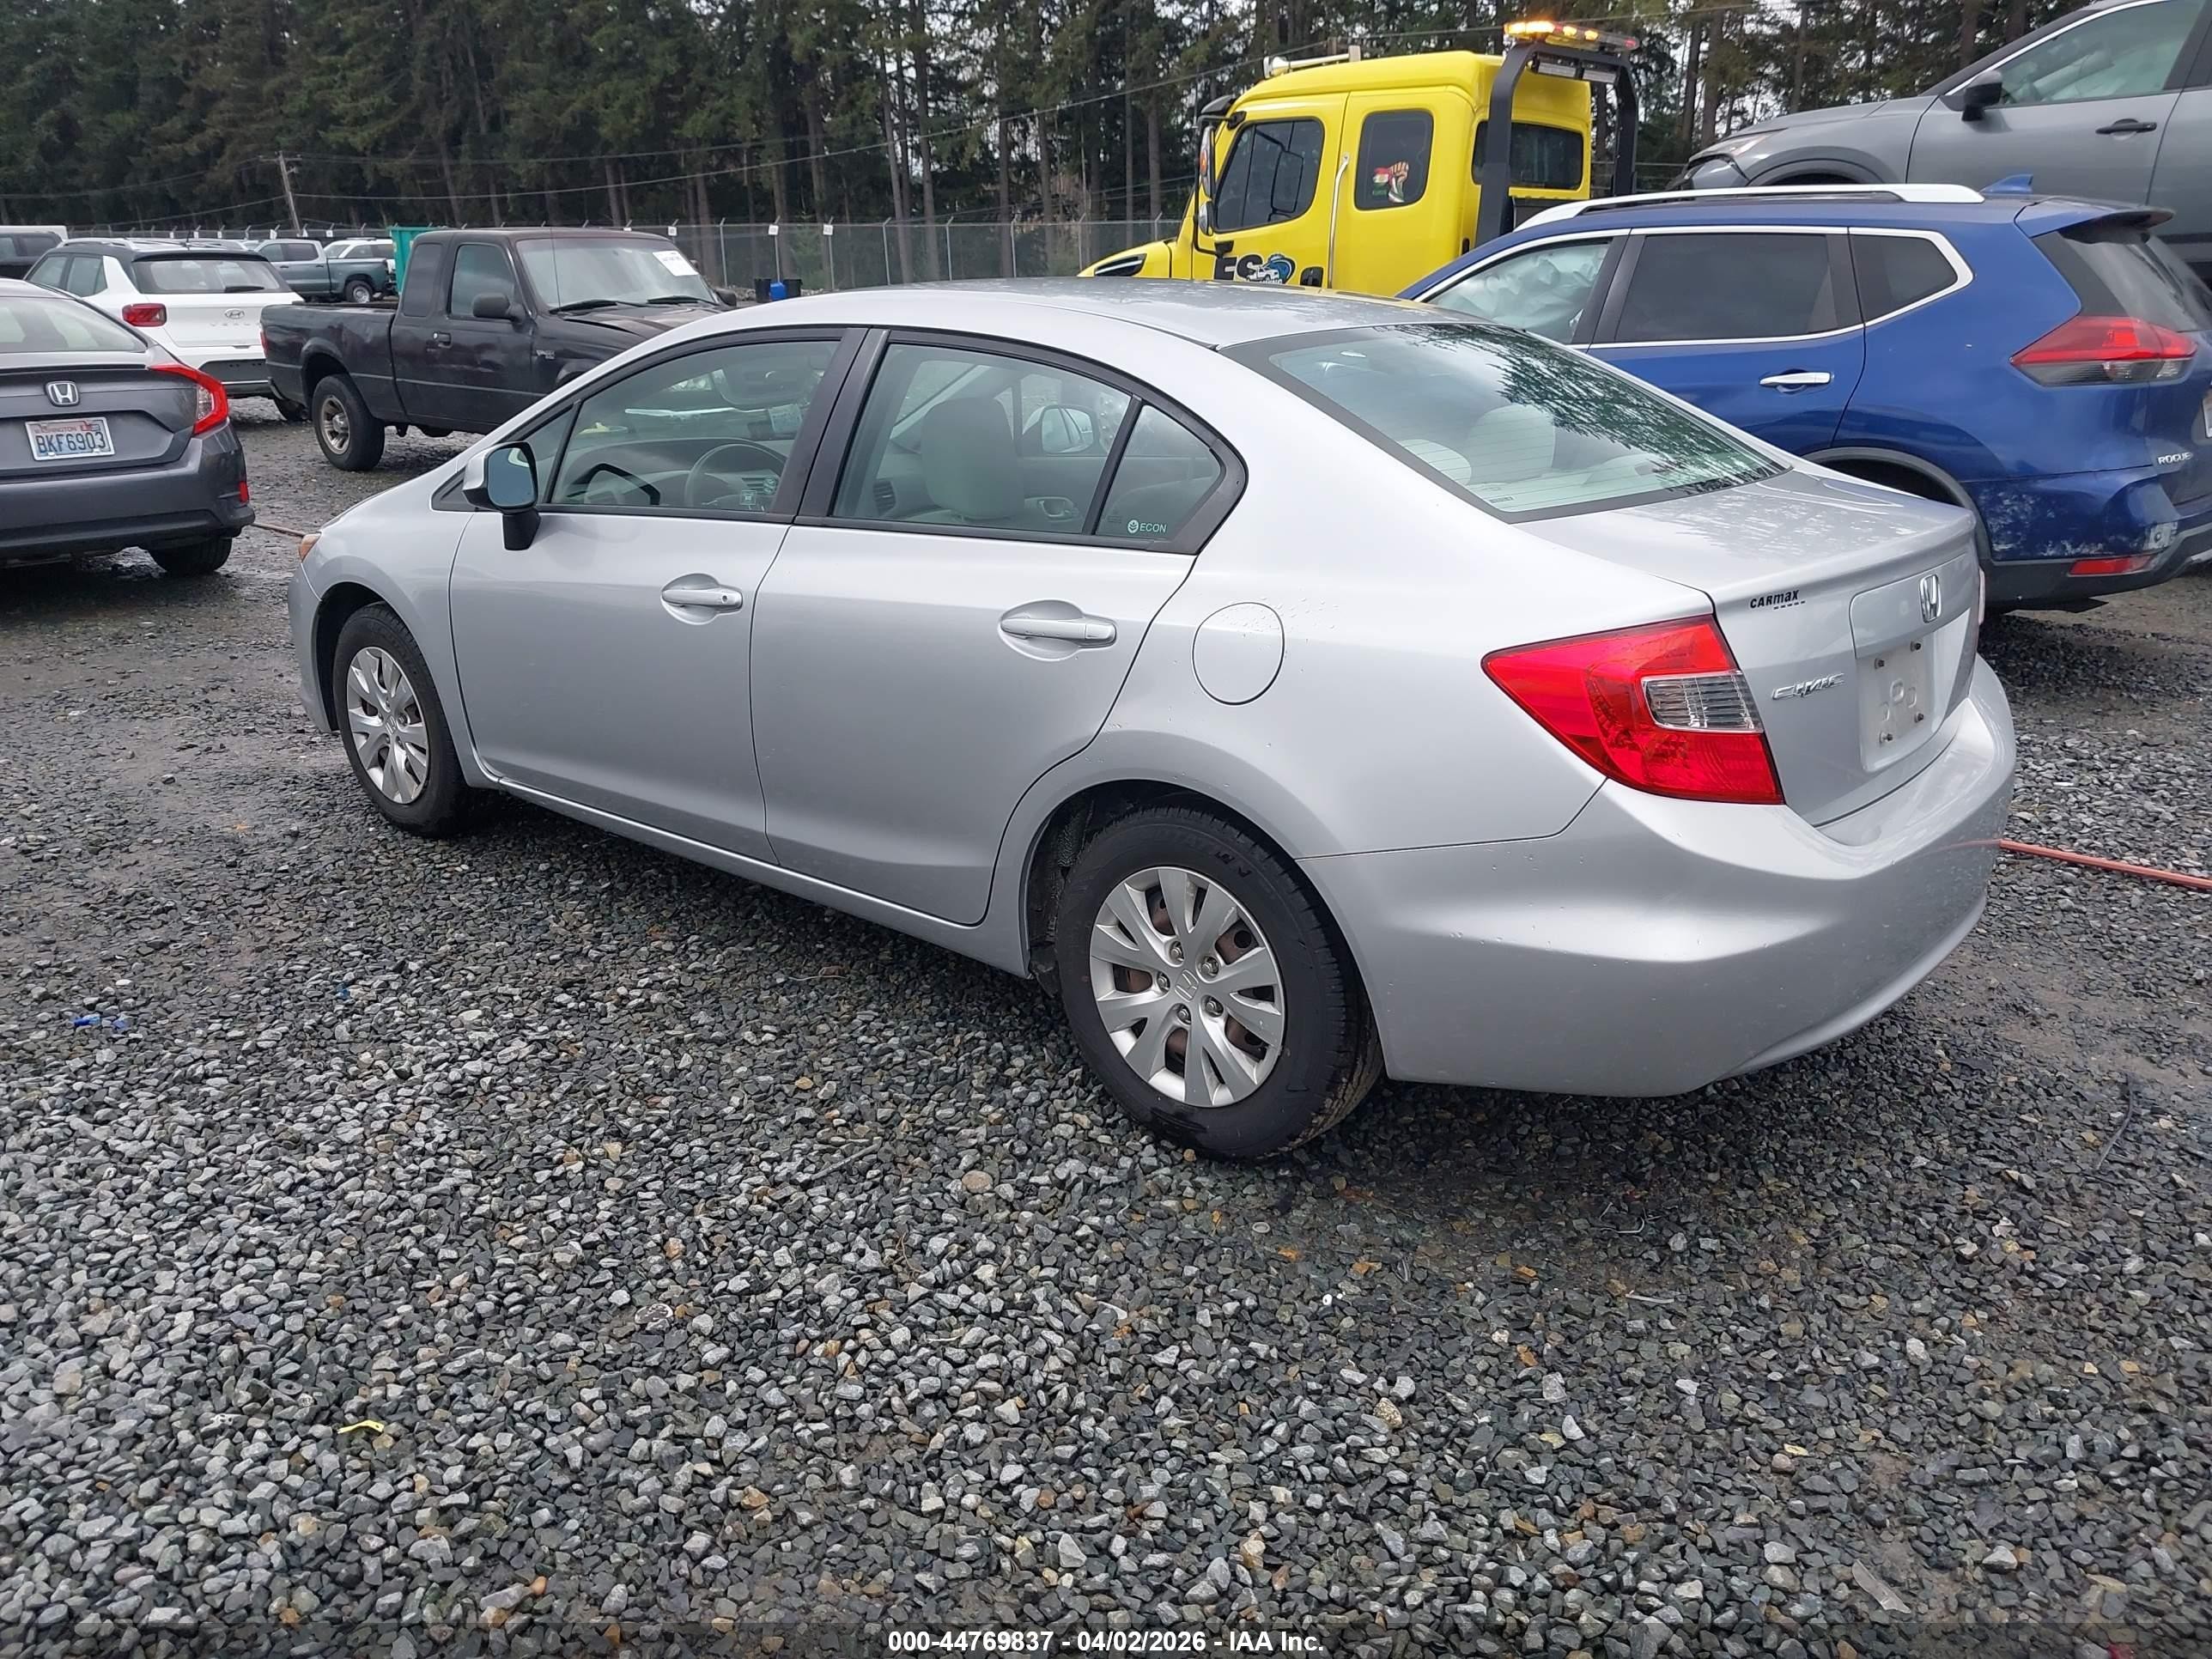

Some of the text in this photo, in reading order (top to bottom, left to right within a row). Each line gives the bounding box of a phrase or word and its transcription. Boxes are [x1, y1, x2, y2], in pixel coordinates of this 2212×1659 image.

[35, 431, 106, 454] BKF6903
[2158, 452, 2192, 465] ROGUE
[1139, 522, 1167, 532] ECON
[1771, 673, 1844, 700] CIVIC
